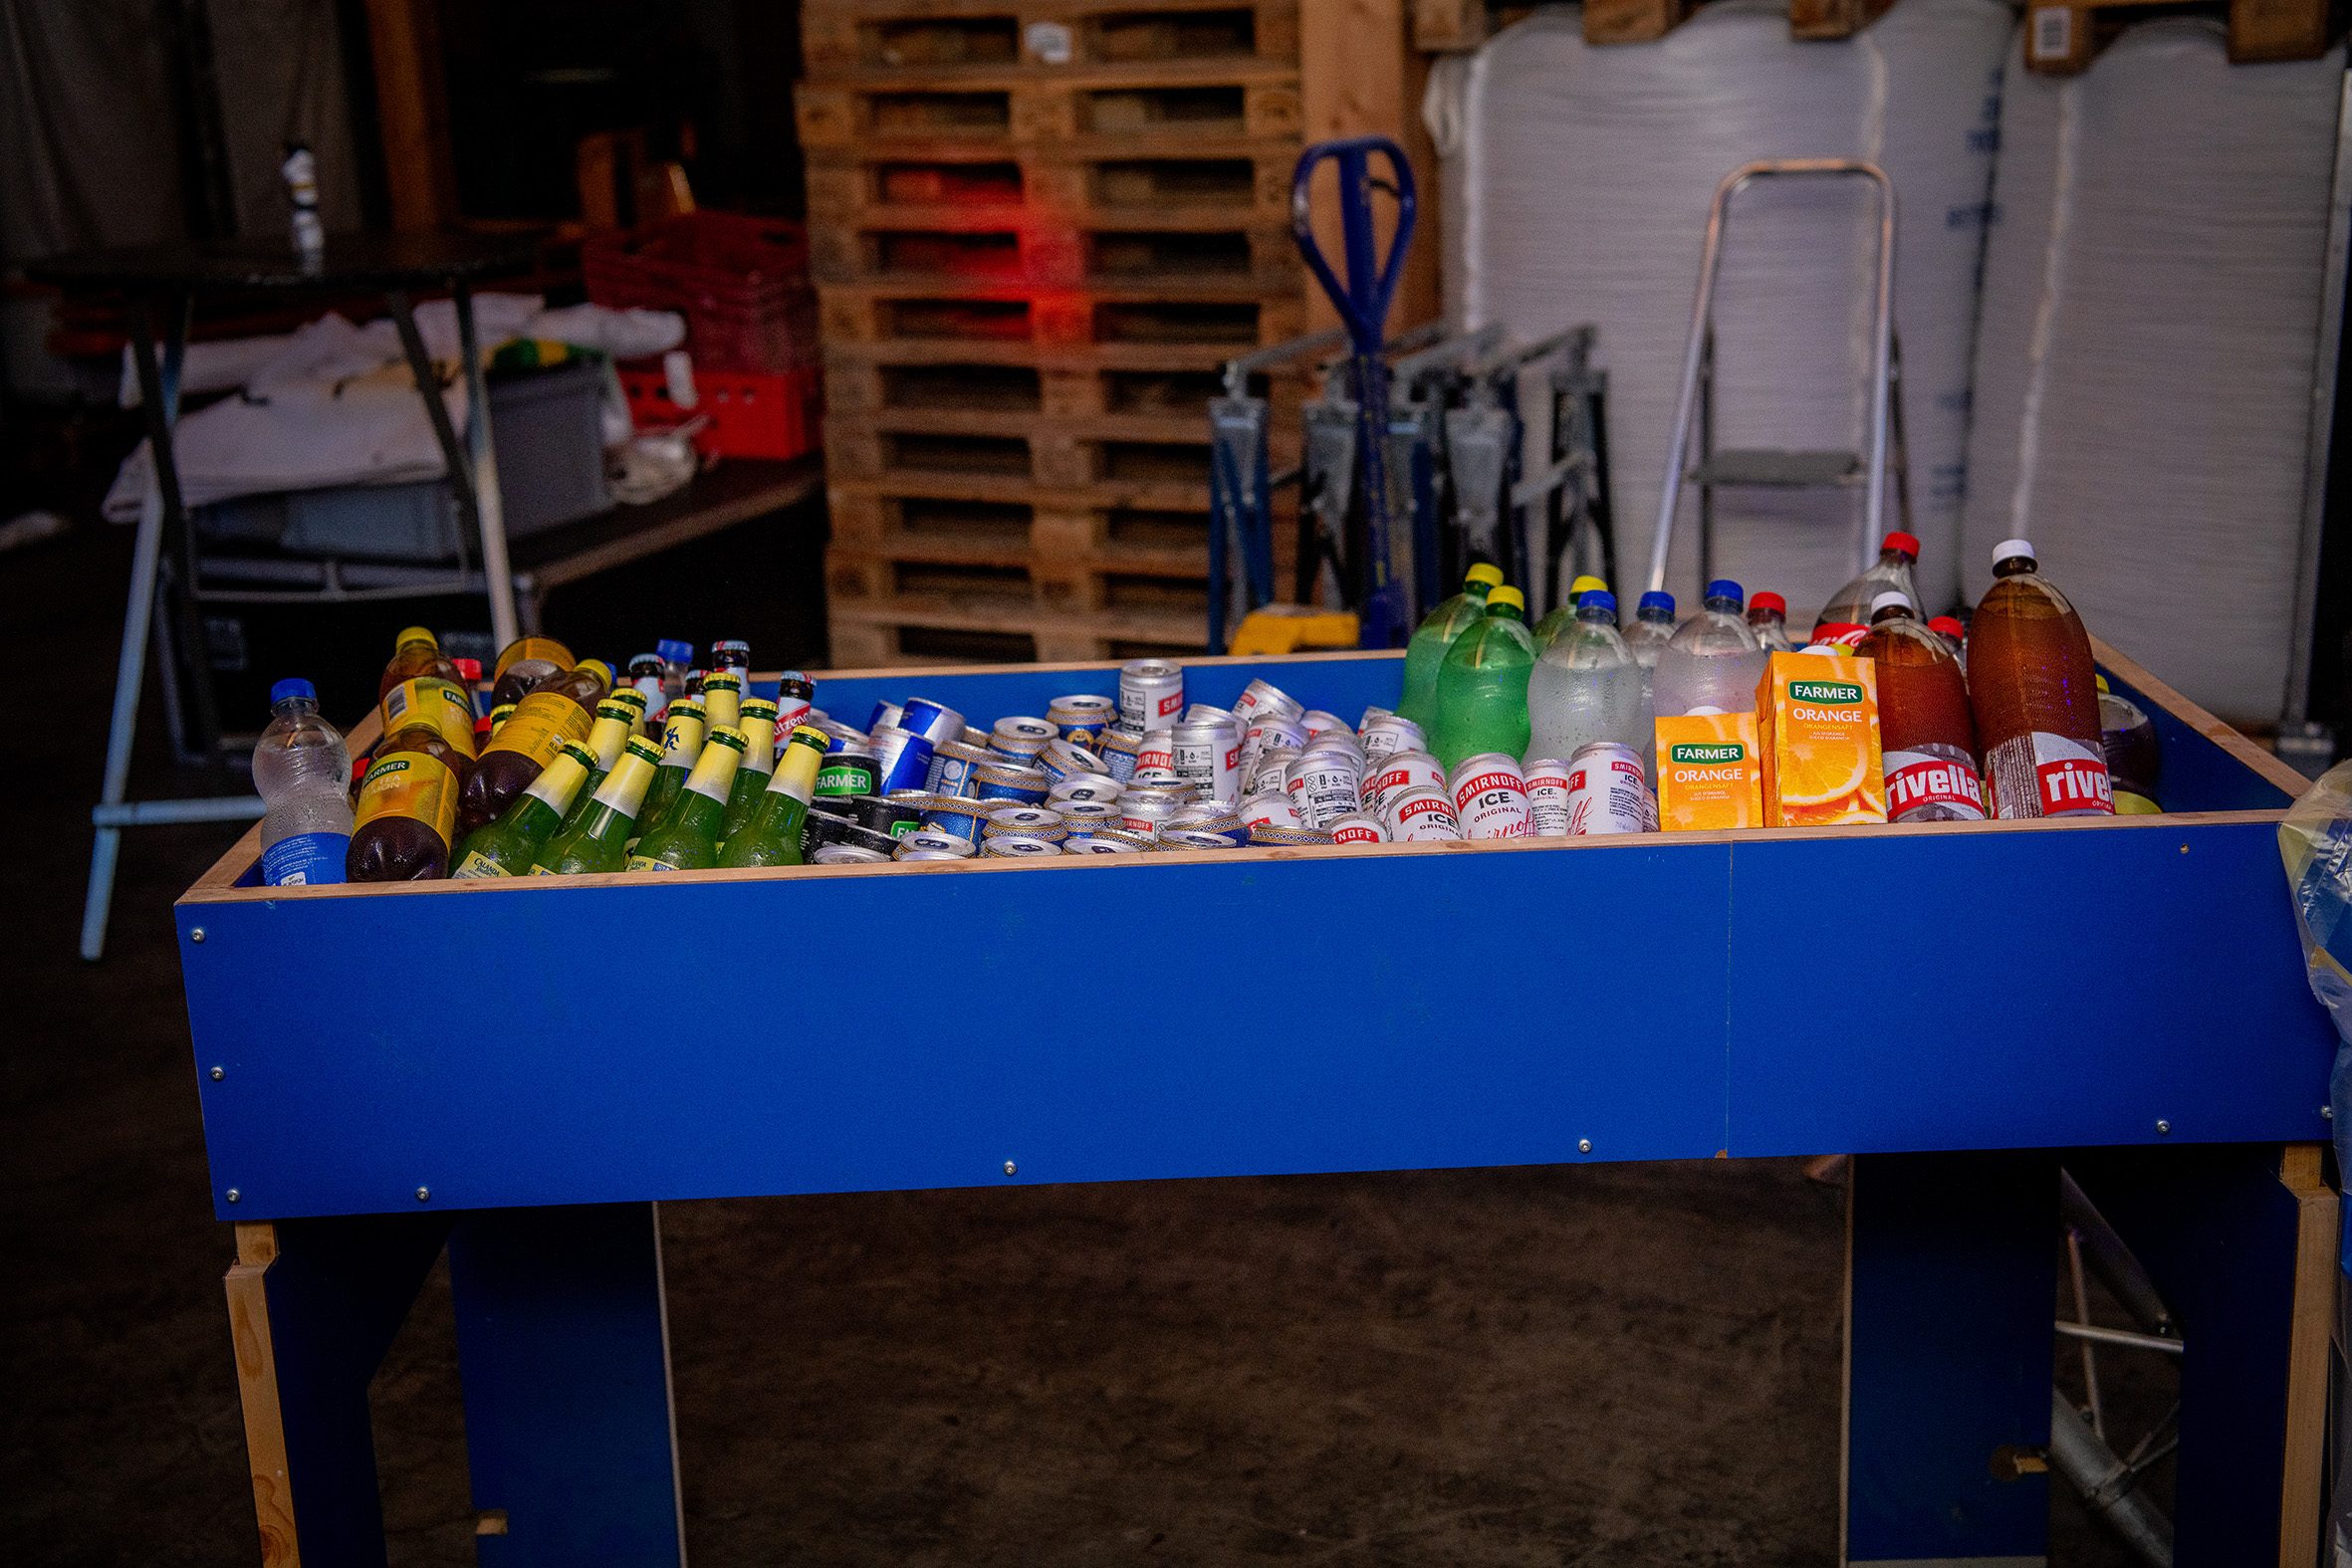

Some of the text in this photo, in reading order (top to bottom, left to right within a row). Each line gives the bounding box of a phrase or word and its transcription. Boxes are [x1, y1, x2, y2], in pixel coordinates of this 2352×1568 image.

[1794, 685, 1858, 700] FARMER
[1792, 707, 1862, 723] ORANGE
[1677, 748, 1740, 760] FARMER
[816, 775, 867, 789] FARMER
[1624, 775, 1638, 785] ICE
[1675, 769, 1744, 783] ORANGE
[1459, 775, 1522, 804] SMIRNOFF
[1528, 779, 1563, 790] SMIRNOFF
[1885, 764, 1984, 812] rivella
[1479, 791, 1512, 809] ICE
[1428, 814, 1456, 829] ICE
[1474, 806, 1522, 822] ORIGINAL
[474, 857, 500, 877] CALANDA
